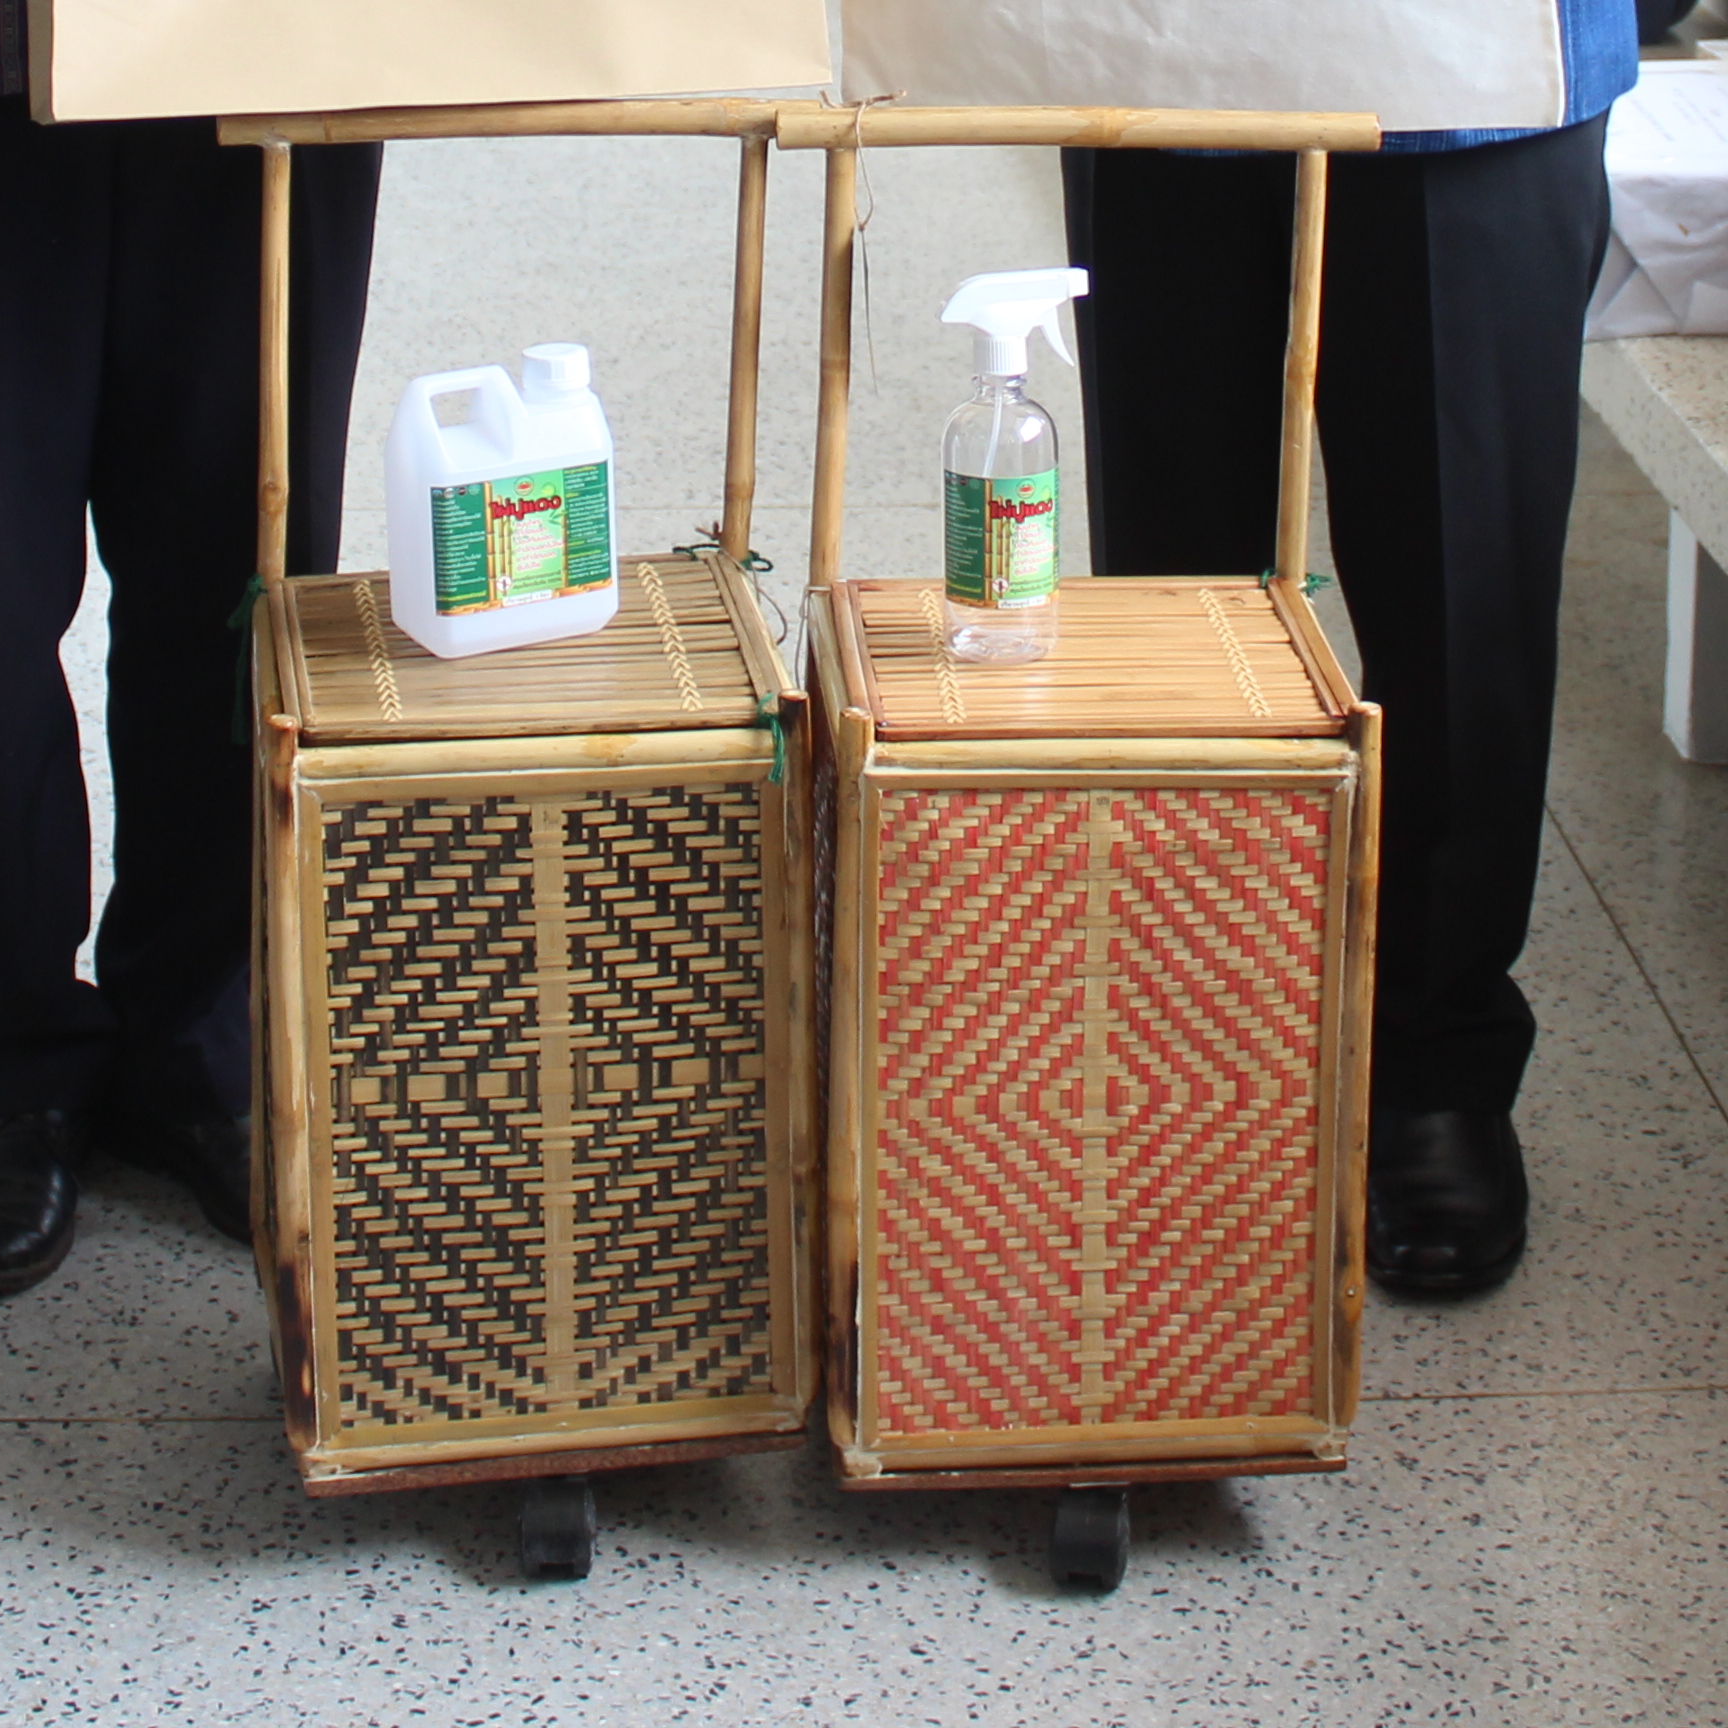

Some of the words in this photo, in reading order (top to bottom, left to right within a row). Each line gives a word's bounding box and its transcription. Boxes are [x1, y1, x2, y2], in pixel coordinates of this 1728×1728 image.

[488, 495, 562, 521] ไผ่ปูแดง
[988, 497, 1053, 524] ไผ่ปูแดง
